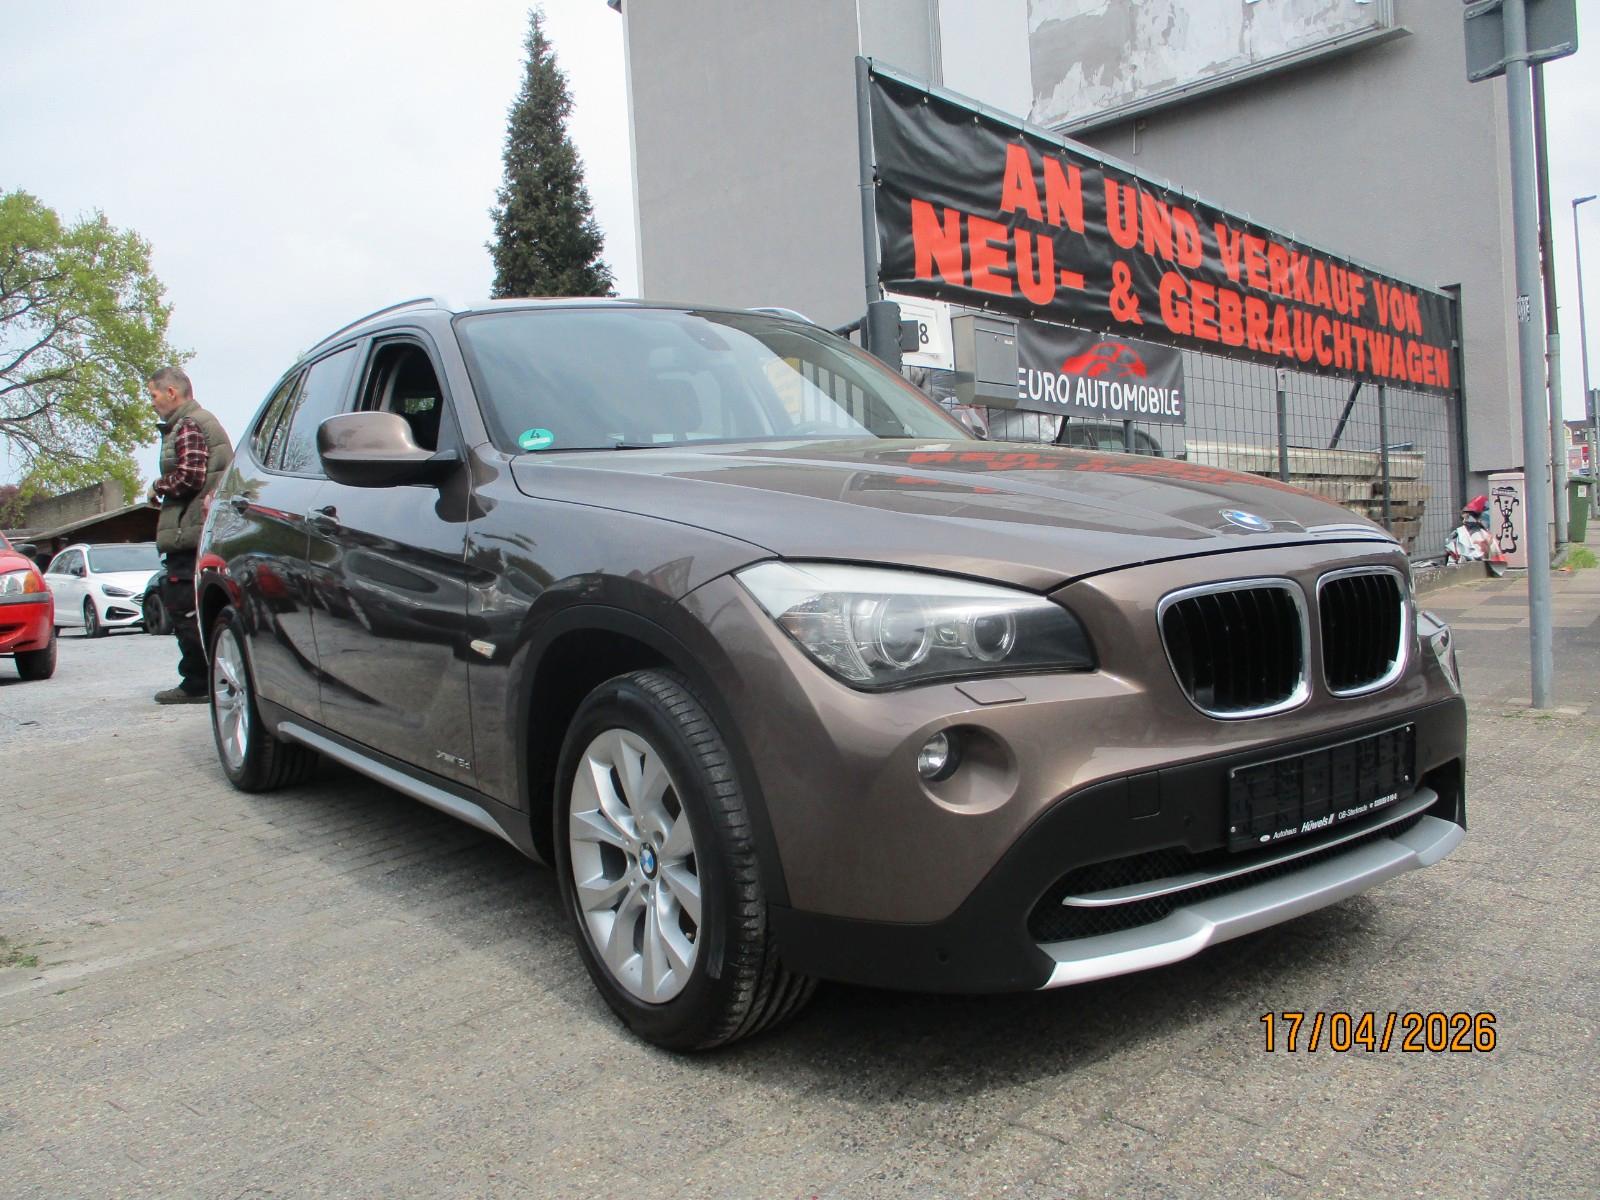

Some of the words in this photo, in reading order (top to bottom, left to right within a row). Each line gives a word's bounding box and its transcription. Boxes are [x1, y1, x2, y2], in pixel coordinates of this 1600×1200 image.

[911, 199, 1085, 305] NEU-
[1109, 260, 1144, 325] &
[1159, 271, 1450, 389] GEBRAUCHTWAGEN
[1001, 143, 1085, 233] AN
[1104, 178, 1203, 268] UND
[1214, 223, 1366, 318] VERKAUF
[1373, 281, 1422, 335] VON
[1018, 367, 1070, 401] EURO
[1075, 376, 1181, 416] AUTOMOBILE
[1273, 827, 1297, 840] Autohaus
